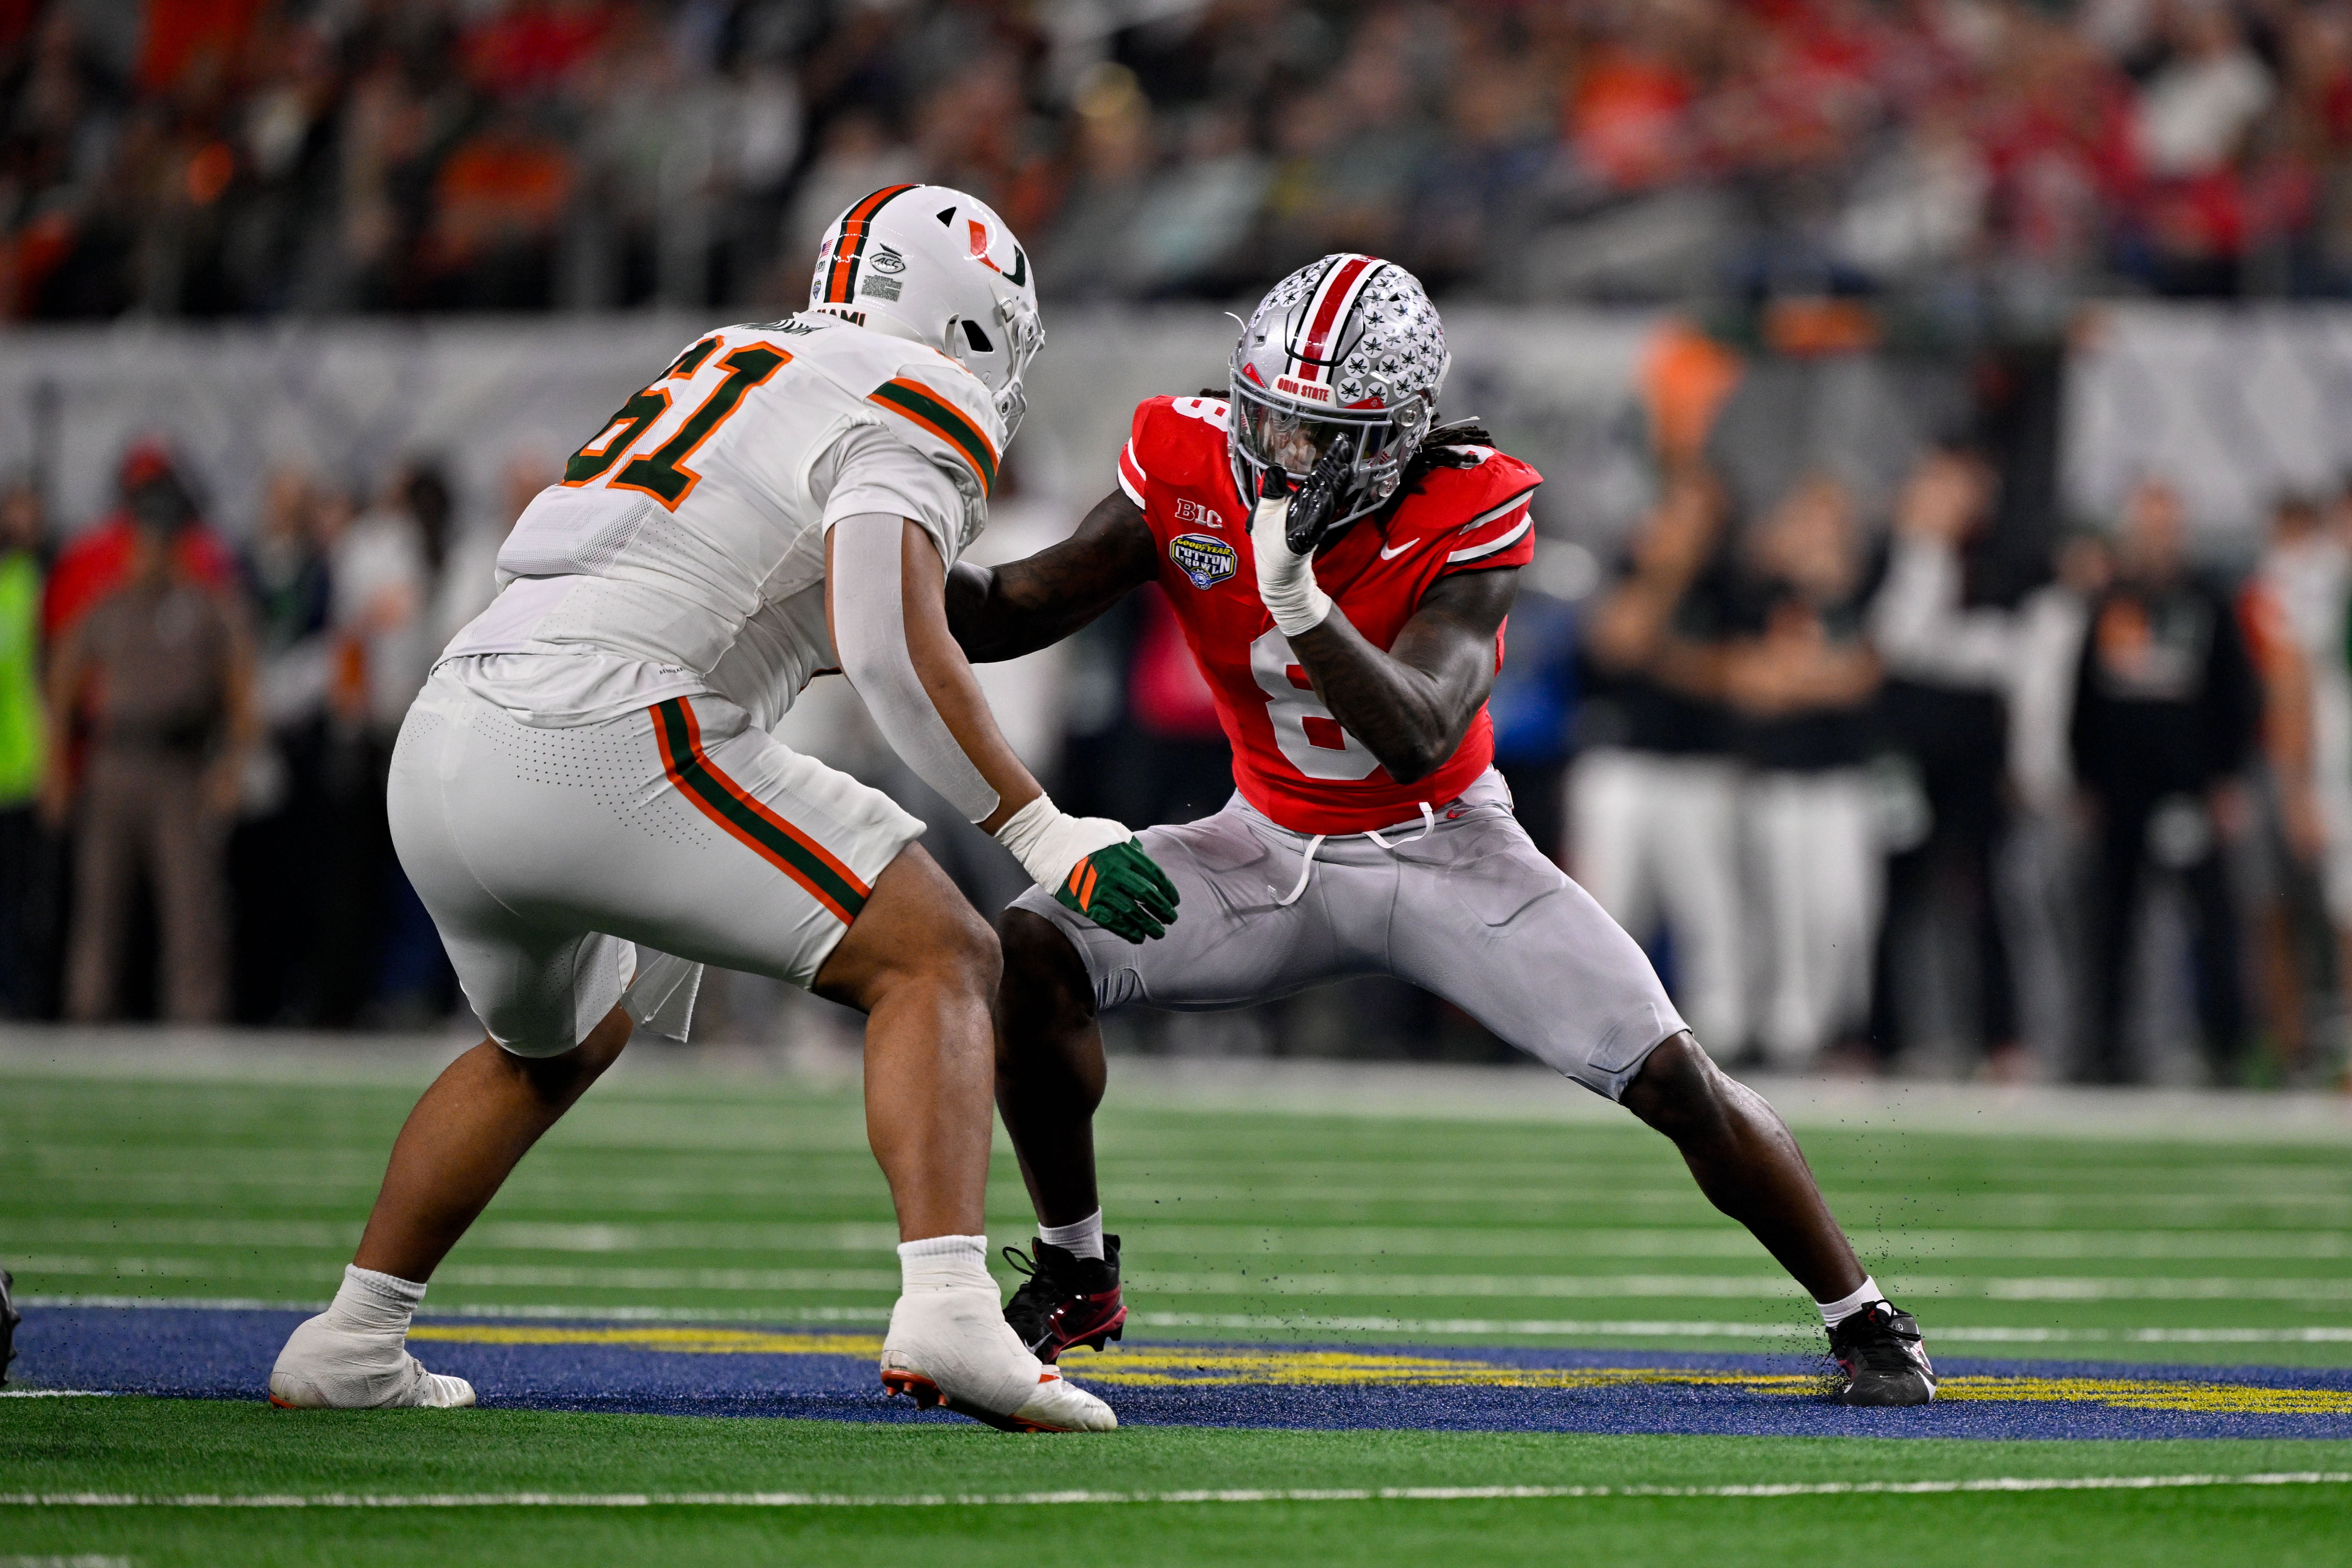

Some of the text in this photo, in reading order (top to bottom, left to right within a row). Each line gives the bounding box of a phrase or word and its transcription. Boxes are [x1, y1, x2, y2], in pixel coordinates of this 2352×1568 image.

[875, 257, 902, 269] ACC
[1277, 378, 1329, 402] OHIO STATE
[556, 335, 794, 513] 61
[1175, 545, 1231, 573] COTTON
[1185, 558, 1219, 575] BOWL
